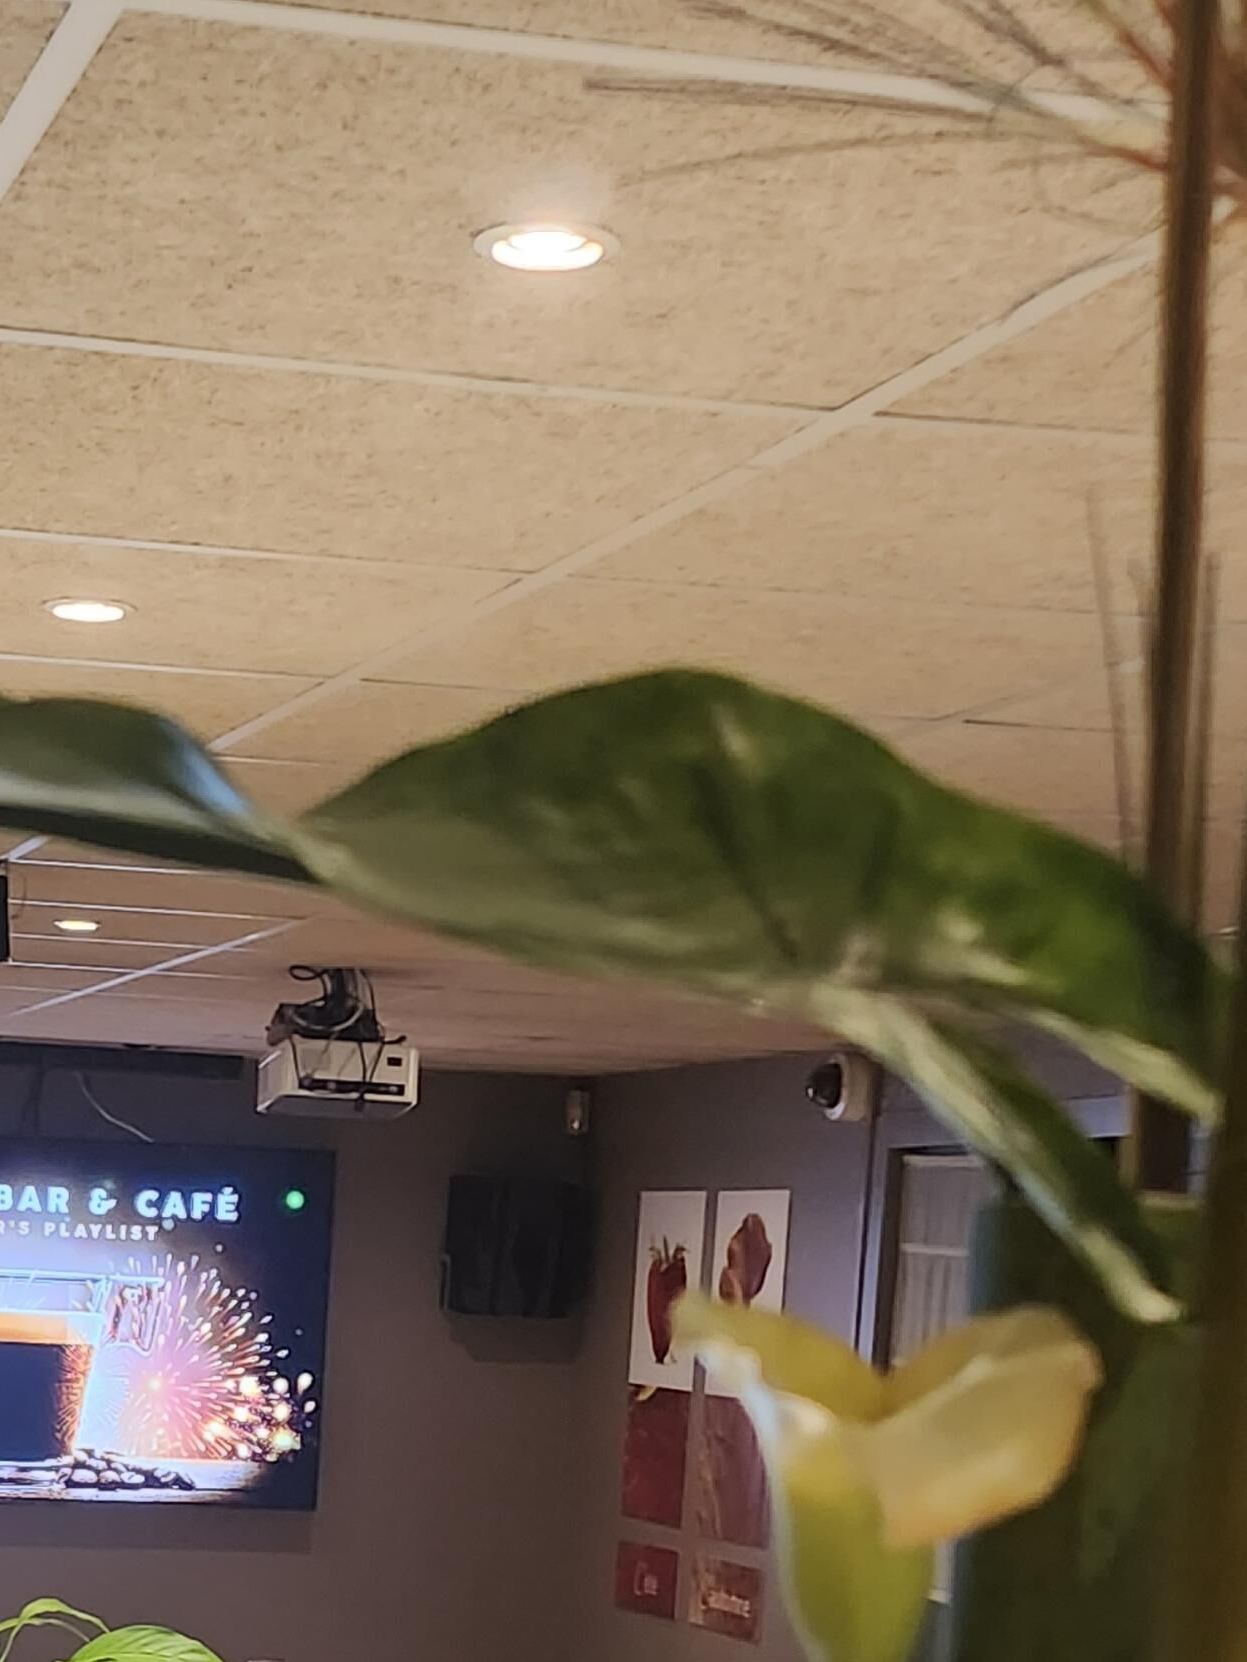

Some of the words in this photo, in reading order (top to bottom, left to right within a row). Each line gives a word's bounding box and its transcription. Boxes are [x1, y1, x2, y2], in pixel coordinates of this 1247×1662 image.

[88, 1187, 118, 1216] &
[134, 1186, 240, 1222] CAFÉ
[43, 1221, 160, 1242] PLAYLIST
